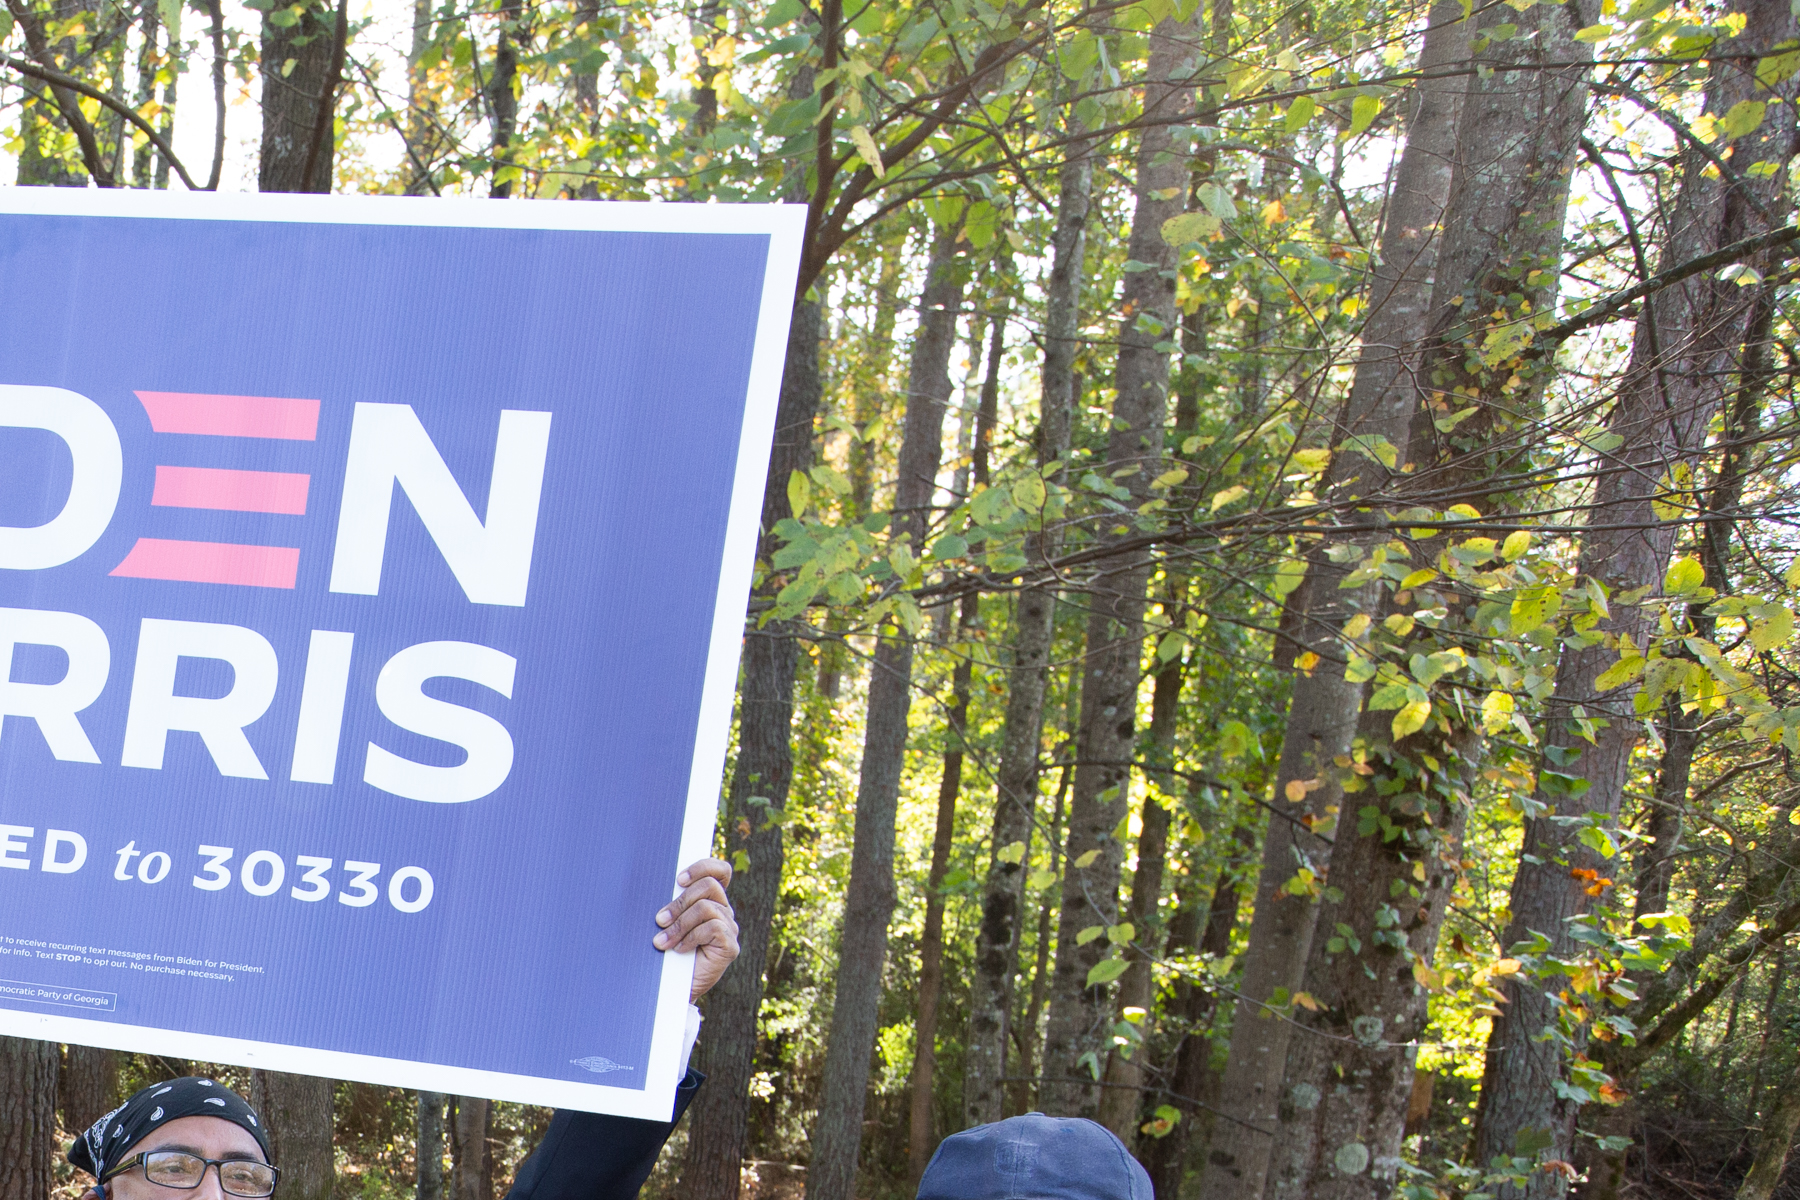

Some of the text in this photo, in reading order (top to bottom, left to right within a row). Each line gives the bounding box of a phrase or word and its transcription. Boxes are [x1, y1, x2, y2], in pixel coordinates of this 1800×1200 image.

[114, 840, 172, 884] to
[192, 844, 434, 913] 30330
[4, 936, 15, 944] to
[15, 938, 47, 948] receive
[48, 941, 88, 954] recurring
[88, 945, 107, 955] text
[107, 948, 152, 961] messages
[152, 952, 175, 963] from
[175, 955, 203, 966] Biden
[204, 958, 218, 968] for
[218, 960, 265, 974] President.
[12, 947, 33, 957] Info.
[34, 949, 54, 960] Text
[54, 952, 82, 963] STOP
[82, 956, 93, 965] to
[92, 958, 109, 967] opt
[109, 960, 128, 969] out.
[129, 961, 144, 971] No
[144, 964, 186, 976] purchase
[186, 969, 235, 982] necessary.
[36, 988, 62, 1001] Party
[61, 992, 73, 1001] of
[72, 993, 109, 1006] Georgia
